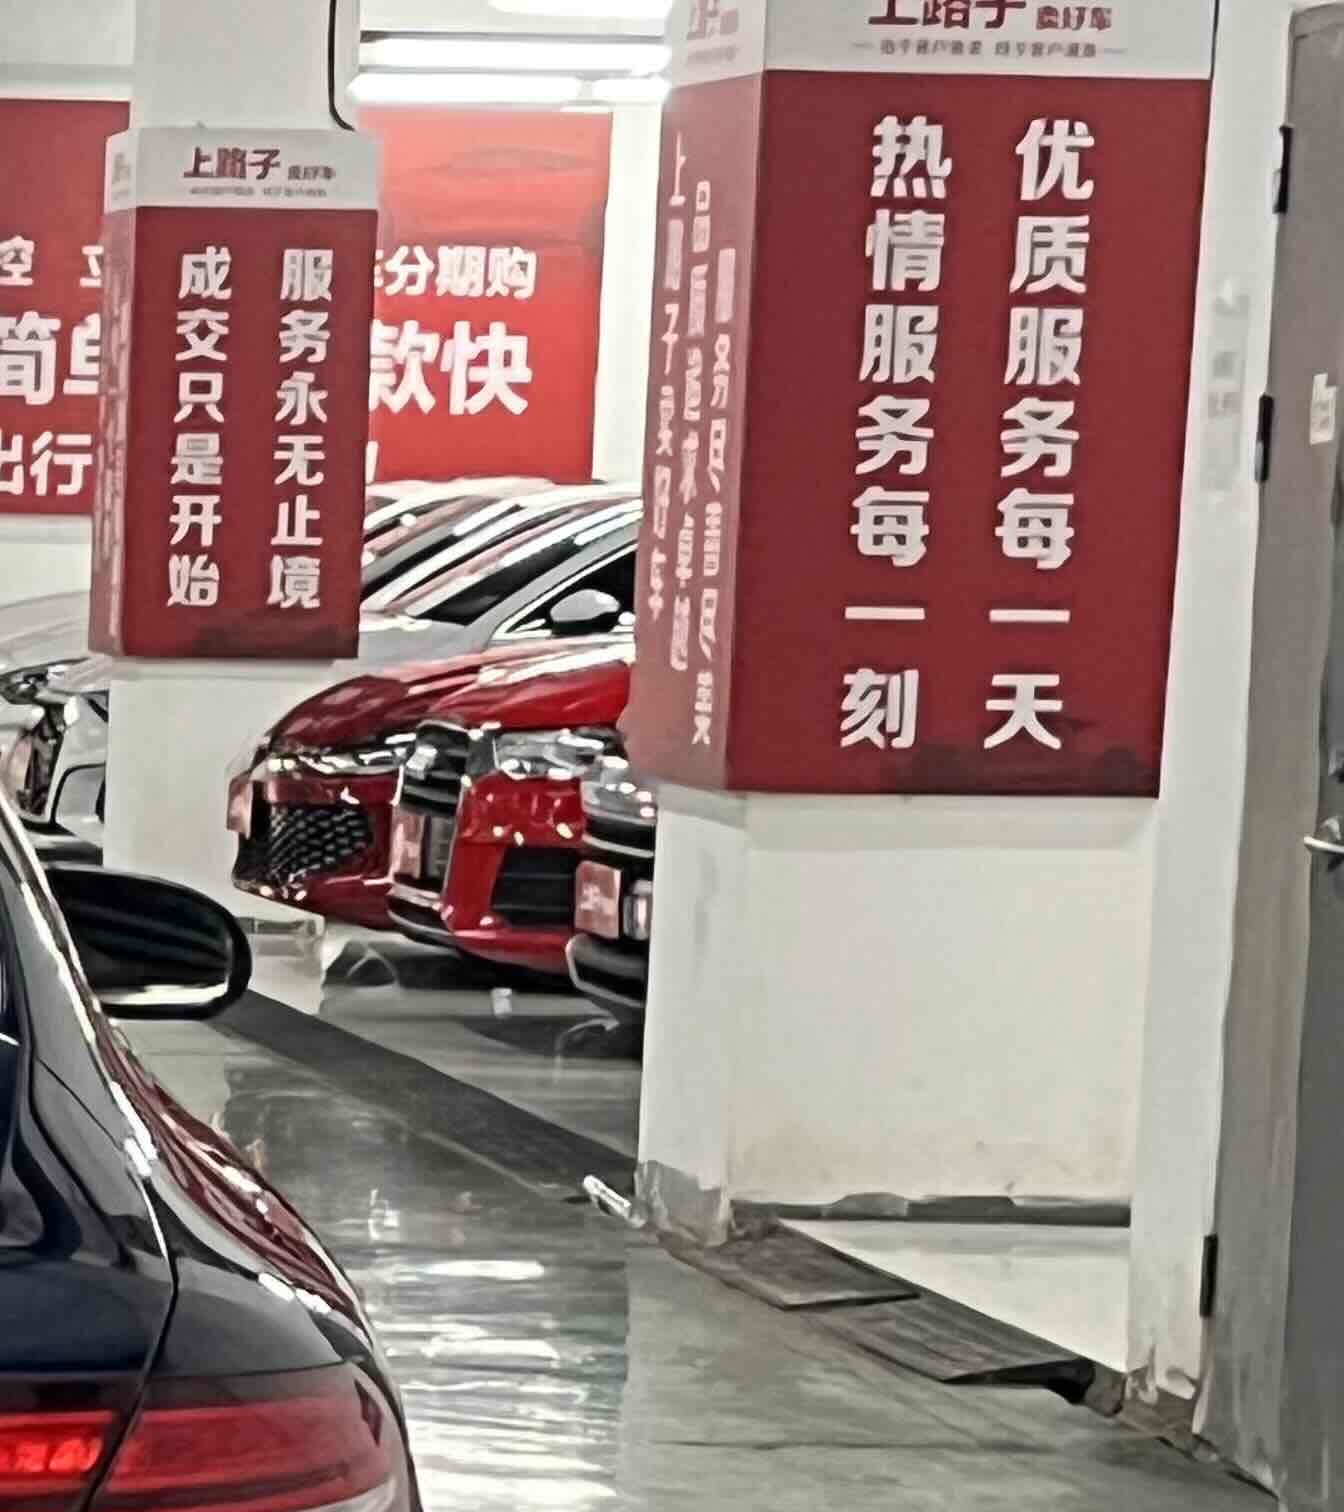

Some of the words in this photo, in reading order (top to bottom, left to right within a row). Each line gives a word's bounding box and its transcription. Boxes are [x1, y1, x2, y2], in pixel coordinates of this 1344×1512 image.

[166, 246, 232, 608] 成交只是开始
[267, 247, 334, 610] 服务永无止境
[840, 115, 953, 750] 热情服务每一刻
[983, 118, 1095, 750] 优质服务每一天
